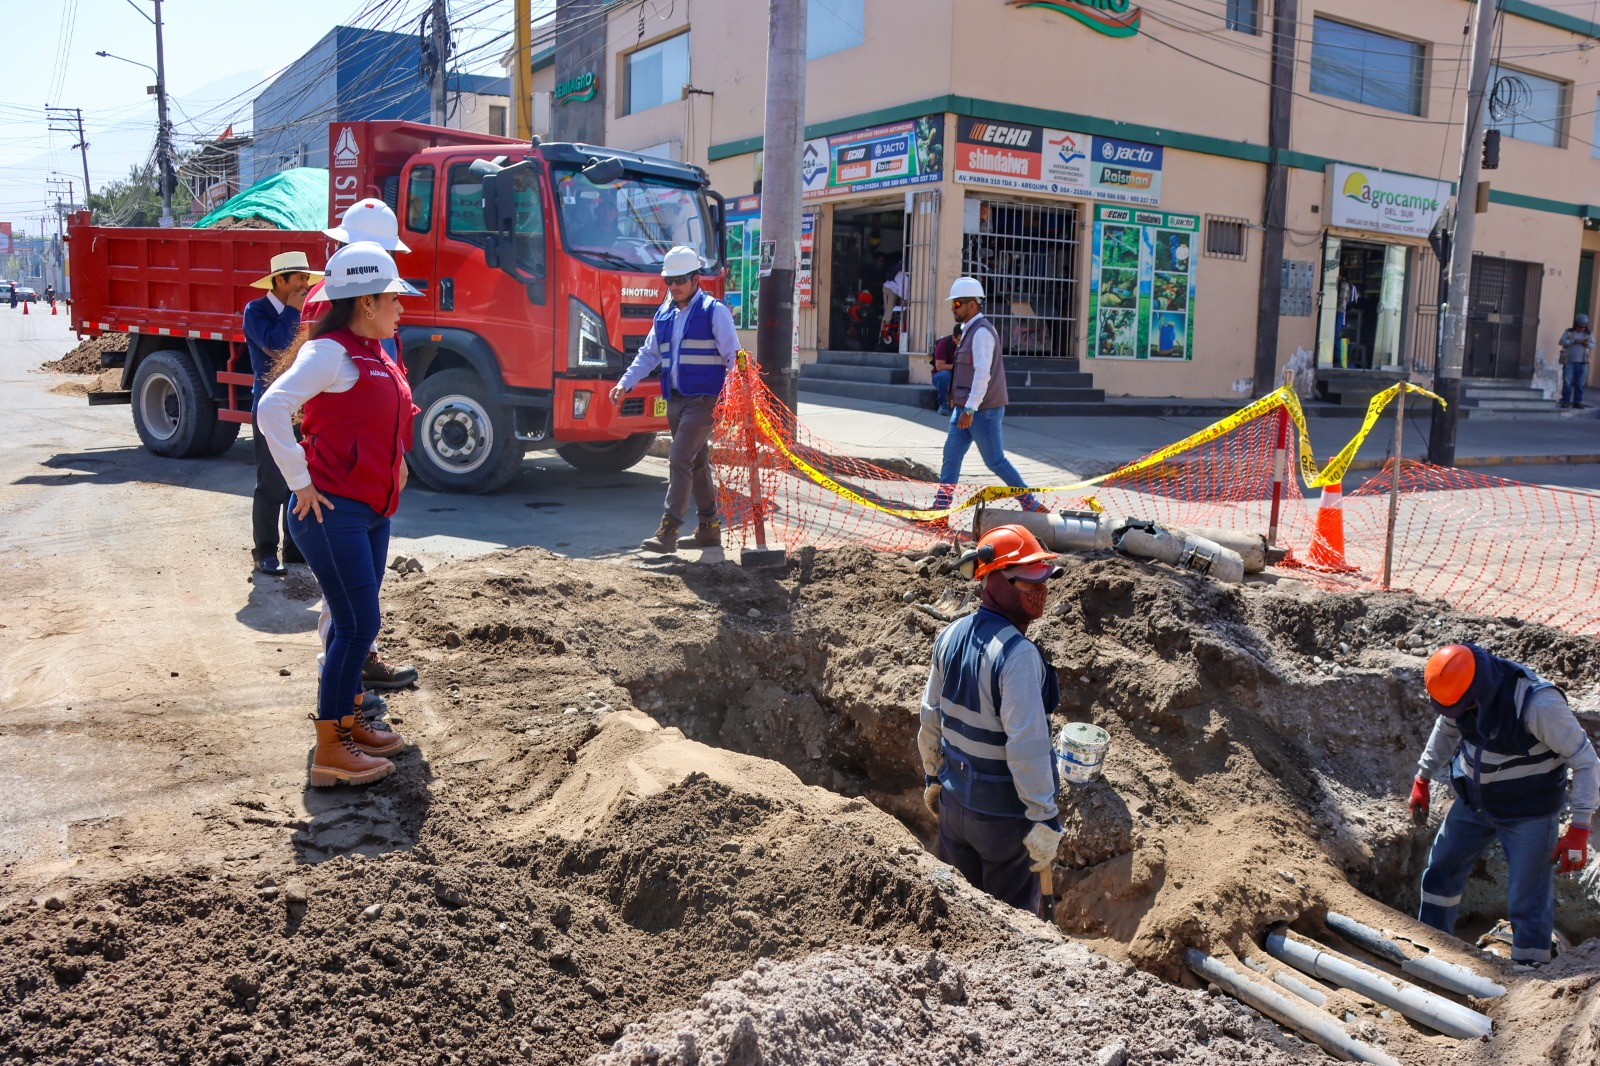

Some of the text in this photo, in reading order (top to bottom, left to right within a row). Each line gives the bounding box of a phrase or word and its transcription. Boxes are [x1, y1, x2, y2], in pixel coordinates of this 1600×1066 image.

[983, 125, 1032, 147] ECHO
[847, 148, 866, 160] ECHO
[882, 142, 905, 154] JACTO
[969, 148, 1028, 175] shindaiwa
[969, 175, 989, 184] PARRA
[990, 177, 1000, 185] 310
[1002, 178, 1012, 187] TDA
[1020, 182, 1048, 190] AREQUIPA
[1103, 168, 1149, 186] Raisman
[1060, 186, 1070, 194] 054
[1107, 210, 1128, 220] ECHO
[1384, 207, 1414, 218] DEL SUR
[346, 265, 380, 276] AREQUIPA
[621, 288, 659, 298] SINOTRUK
